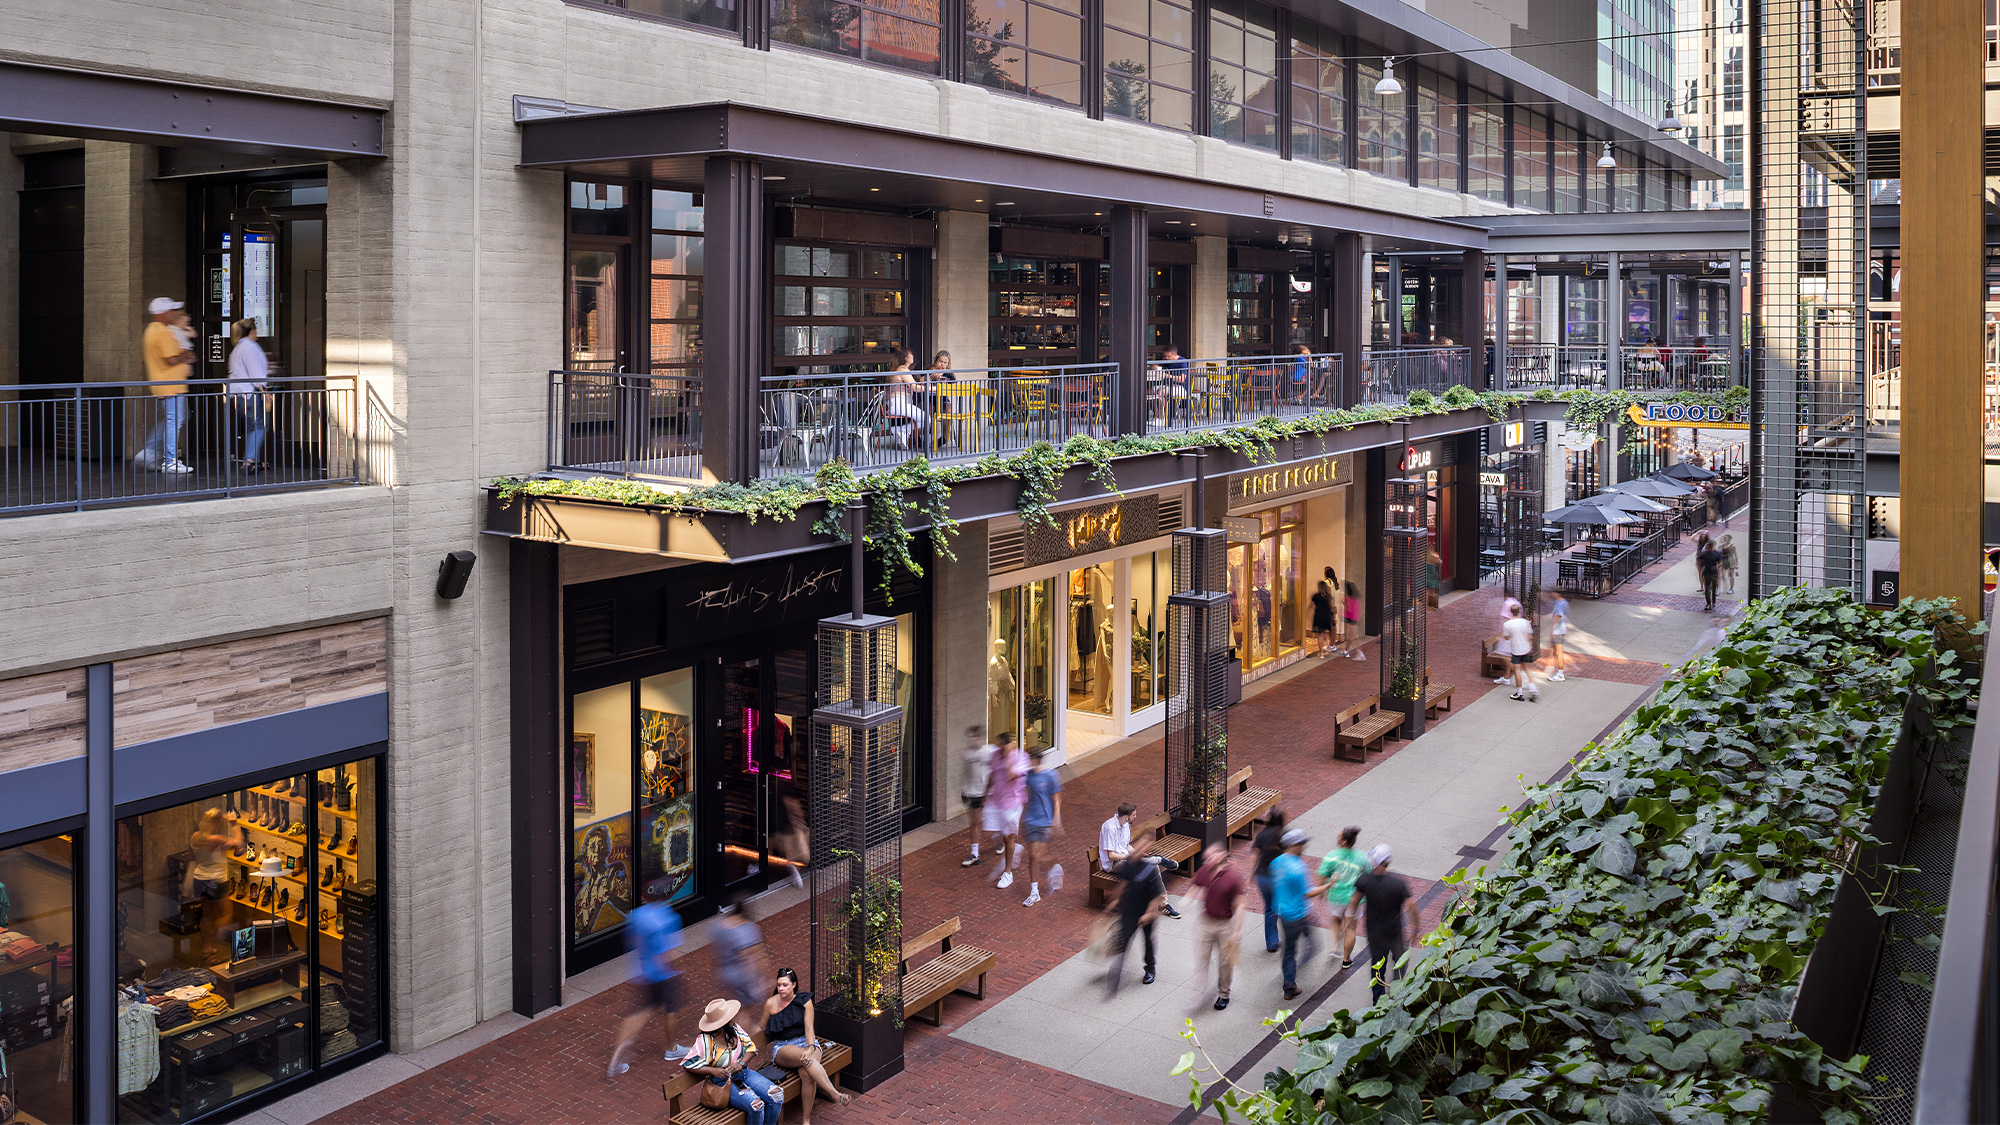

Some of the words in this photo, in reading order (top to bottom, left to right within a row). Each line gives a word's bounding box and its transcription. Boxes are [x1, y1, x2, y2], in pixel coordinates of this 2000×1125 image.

[1647, 402, 1726, 422] FOOD
[1418, 450, 1431, 467] LAB
[1243, 471, 1281, 498] FREE
[1285, 460, 1338, 488] PEOPLE
[1480, 474, 1501, 484] CAVA
[1223, 520, 1244, 529] FREE
[1229, 530, 1258, 539] EOPLE
